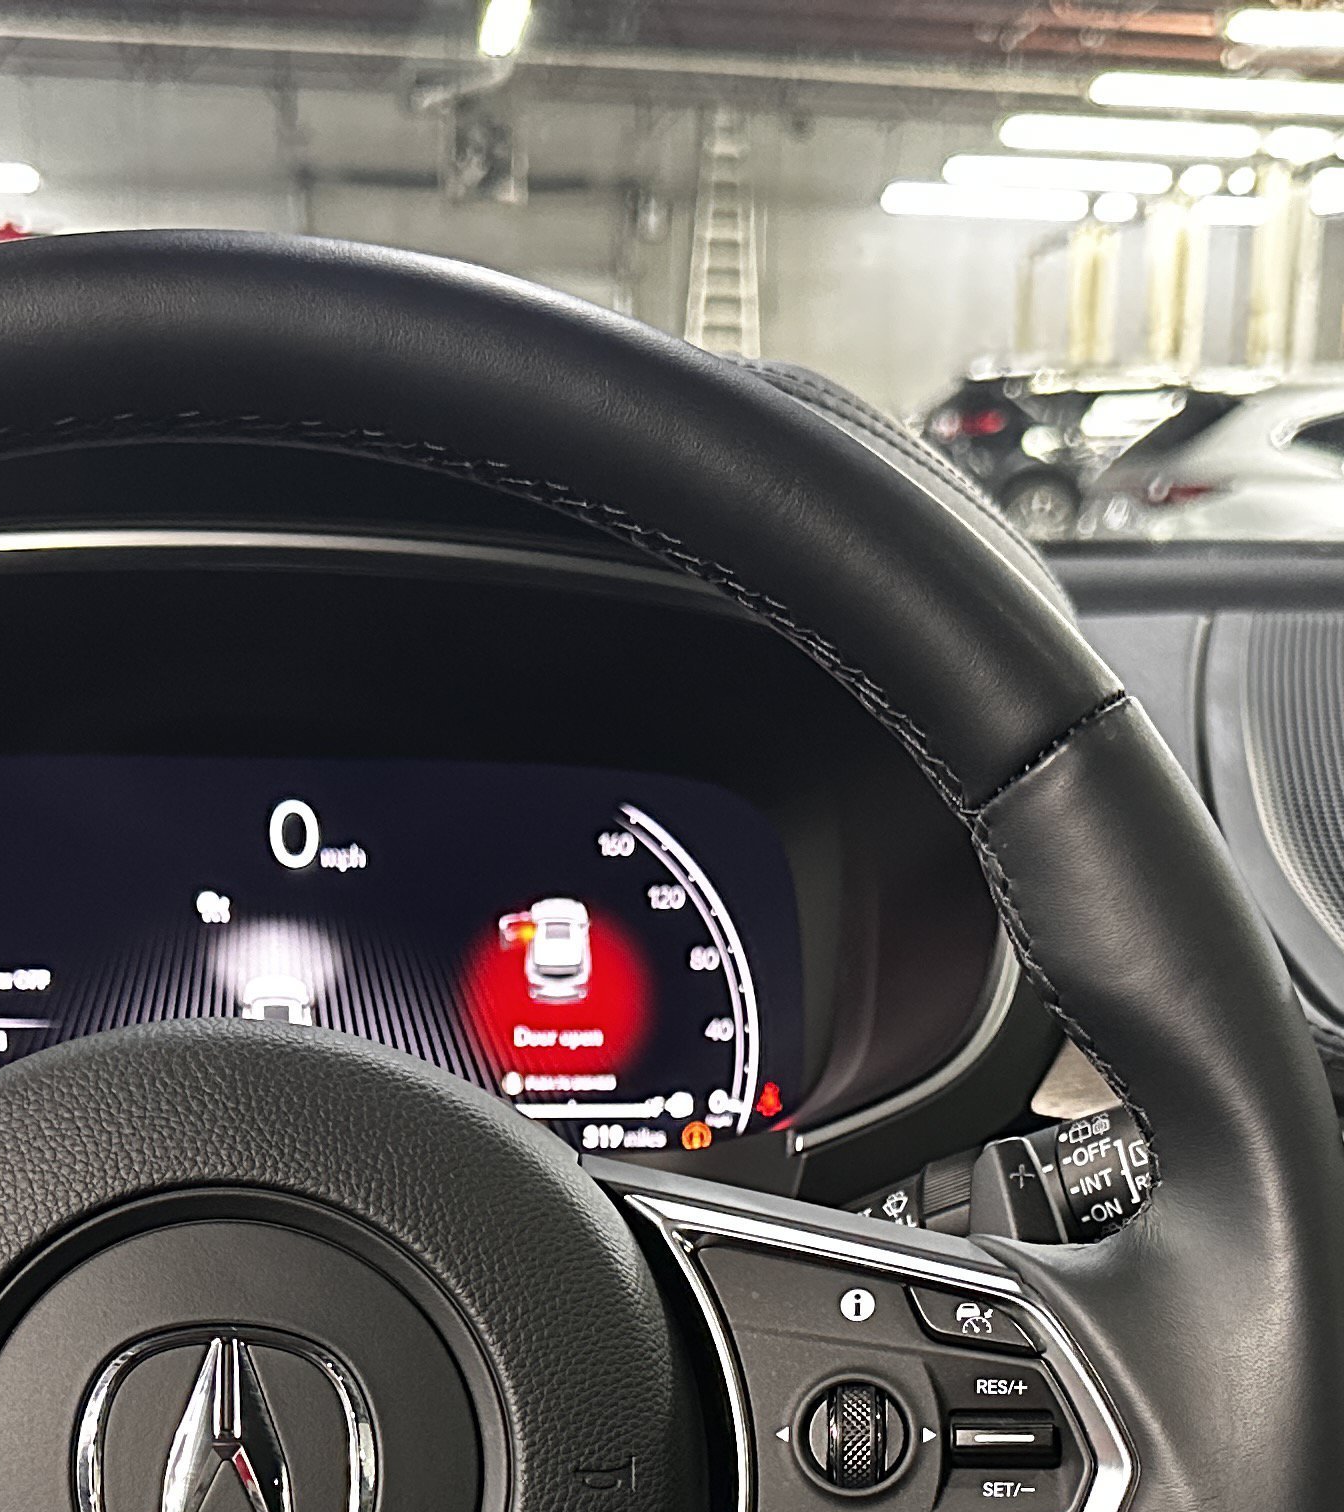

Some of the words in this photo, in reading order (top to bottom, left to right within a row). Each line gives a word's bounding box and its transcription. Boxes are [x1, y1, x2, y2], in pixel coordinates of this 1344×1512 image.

[269, 799, 320, 869] 0
[320, 842, 367, 873] mph
[598, 831, 635, 858] 160
[647, 885, 686, 911] 120
[689, 946, 720, 971] 80
[704, 1017, 734, 1041] 40
[1072, 1137, 1112, 1168] OFF
[1079, 1167, 1113, 1196] INT
[1090, 1198, 1124, 1223] ON
[976, 1379, 1028, 1396] RES/+
